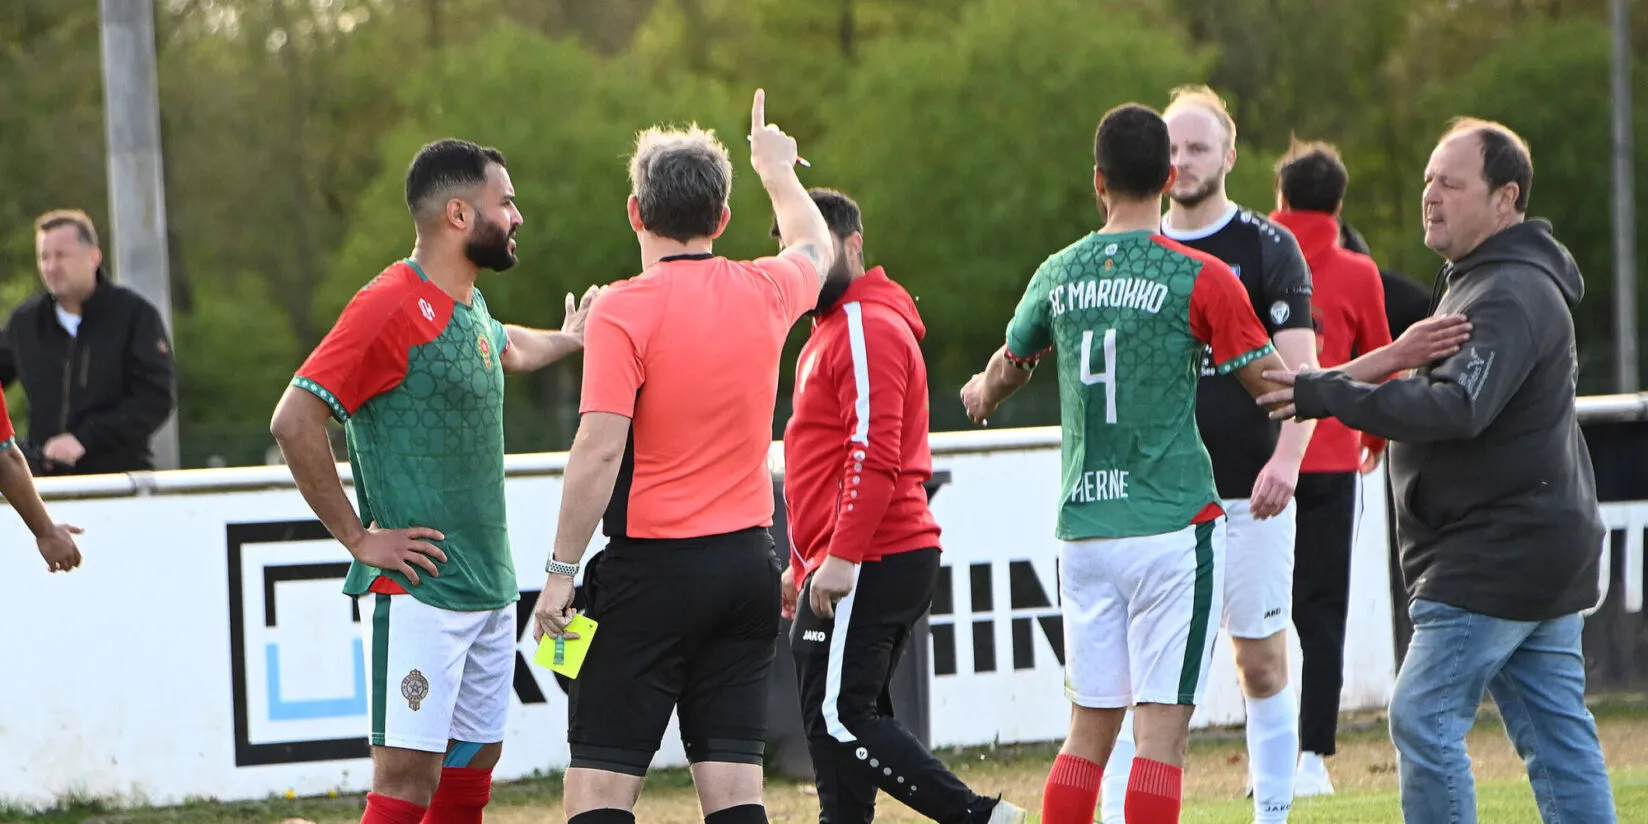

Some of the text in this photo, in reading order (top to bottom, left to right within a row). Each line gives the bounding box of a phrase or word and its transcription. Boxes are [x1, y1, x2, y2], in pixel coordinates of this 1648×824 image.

[1068, 277, 1169, 315] MAROKKO
[1080, 328, 1118, 424] 4
[1071, 468, 1130, 503] HERNE
[802, 629, 826, 643] JAKO
